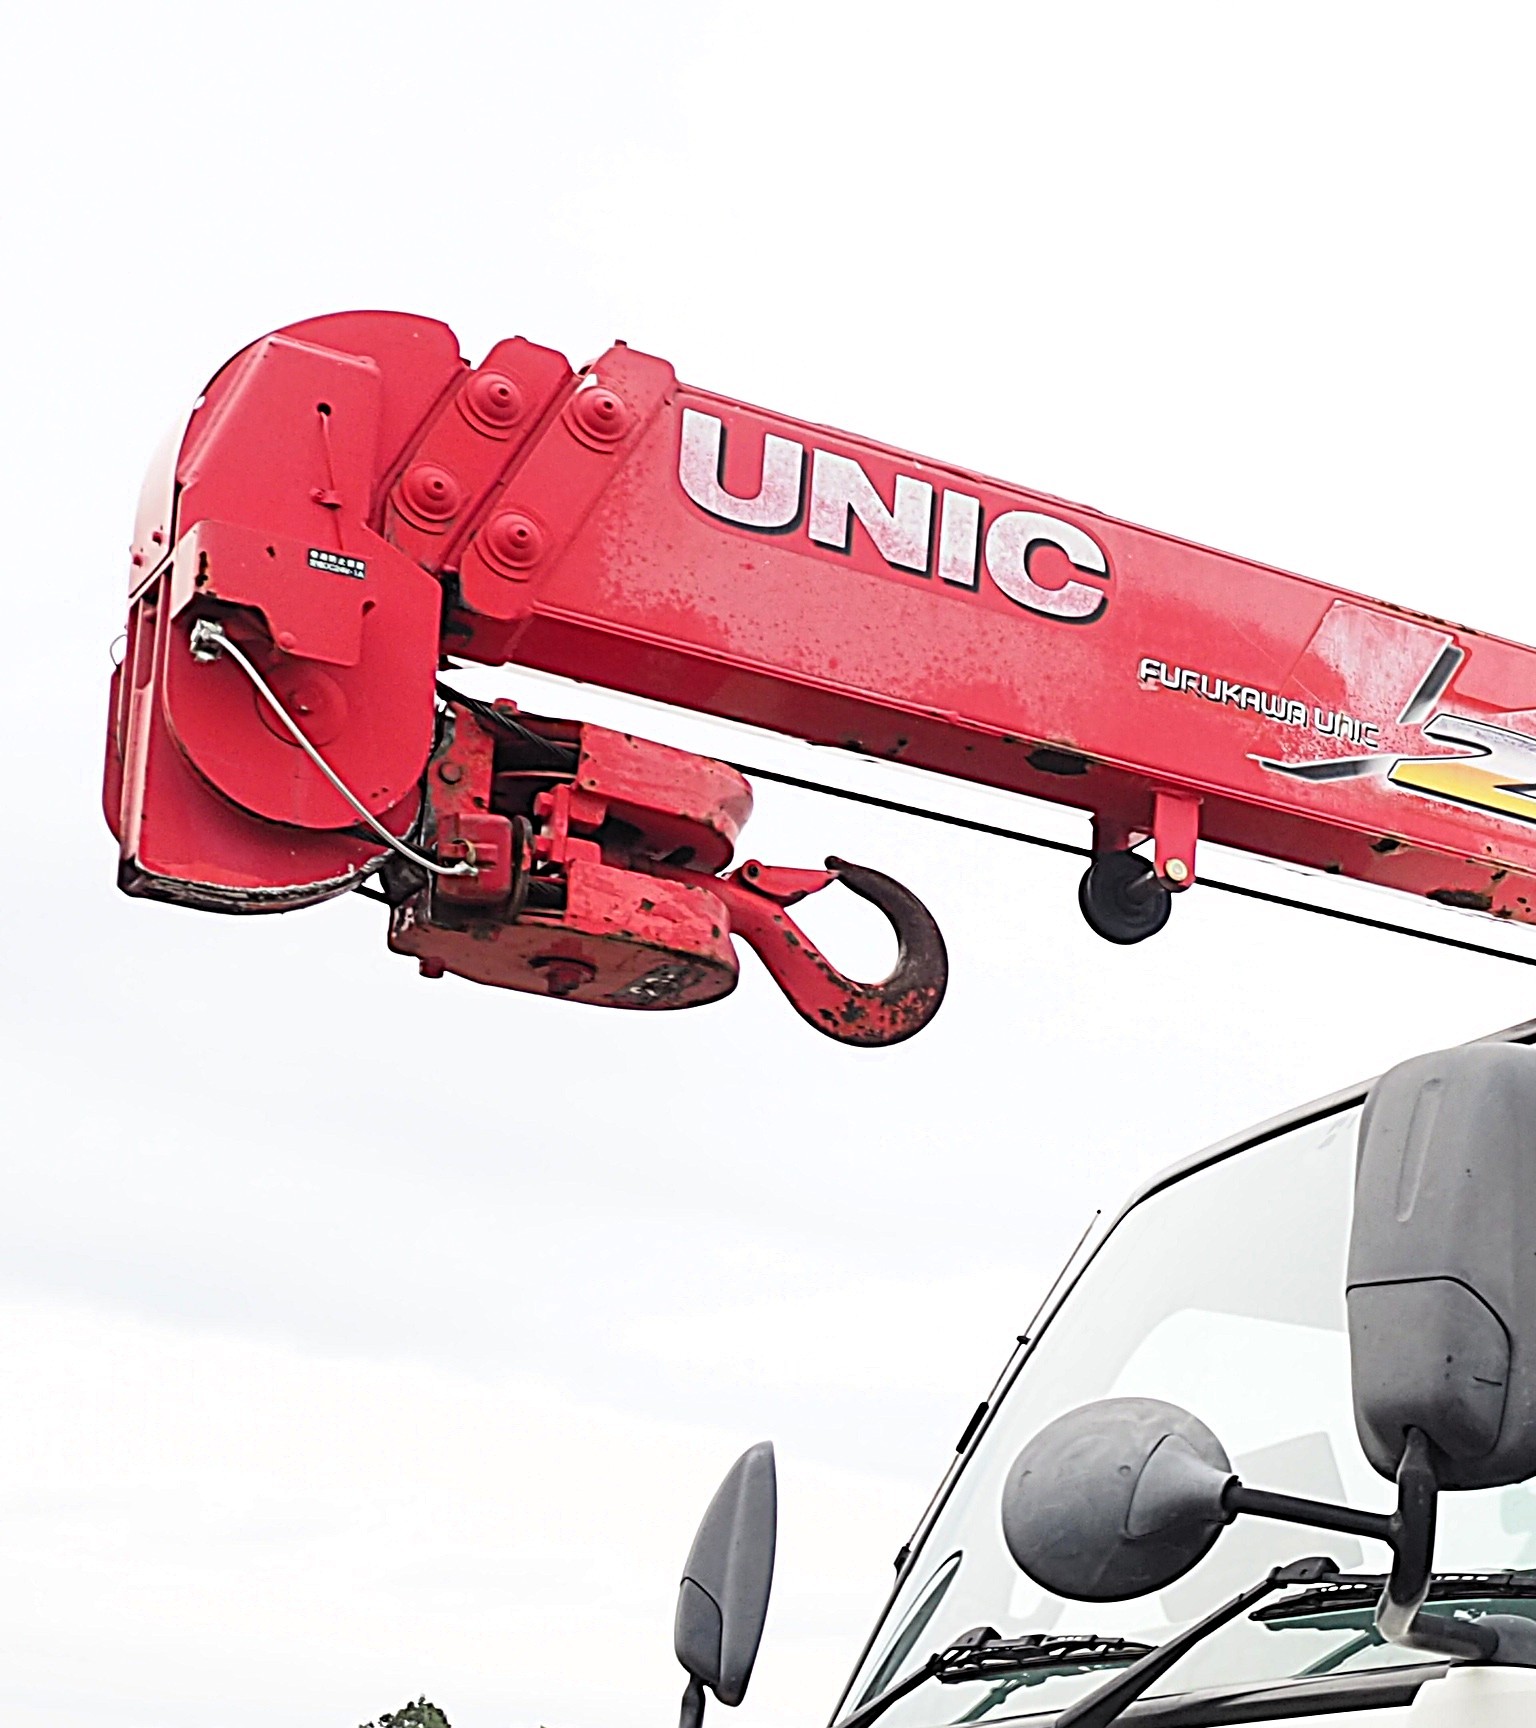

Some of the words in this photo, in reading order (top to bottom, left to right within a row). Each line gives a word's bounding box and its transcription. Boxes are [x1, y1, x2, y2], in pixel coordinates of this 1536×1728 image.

[678, 407, 1110, 625] UNIC
[1139, 657, 1309, 729] FURUKAWA
[1313, 706, 1380, 750] UNIC
